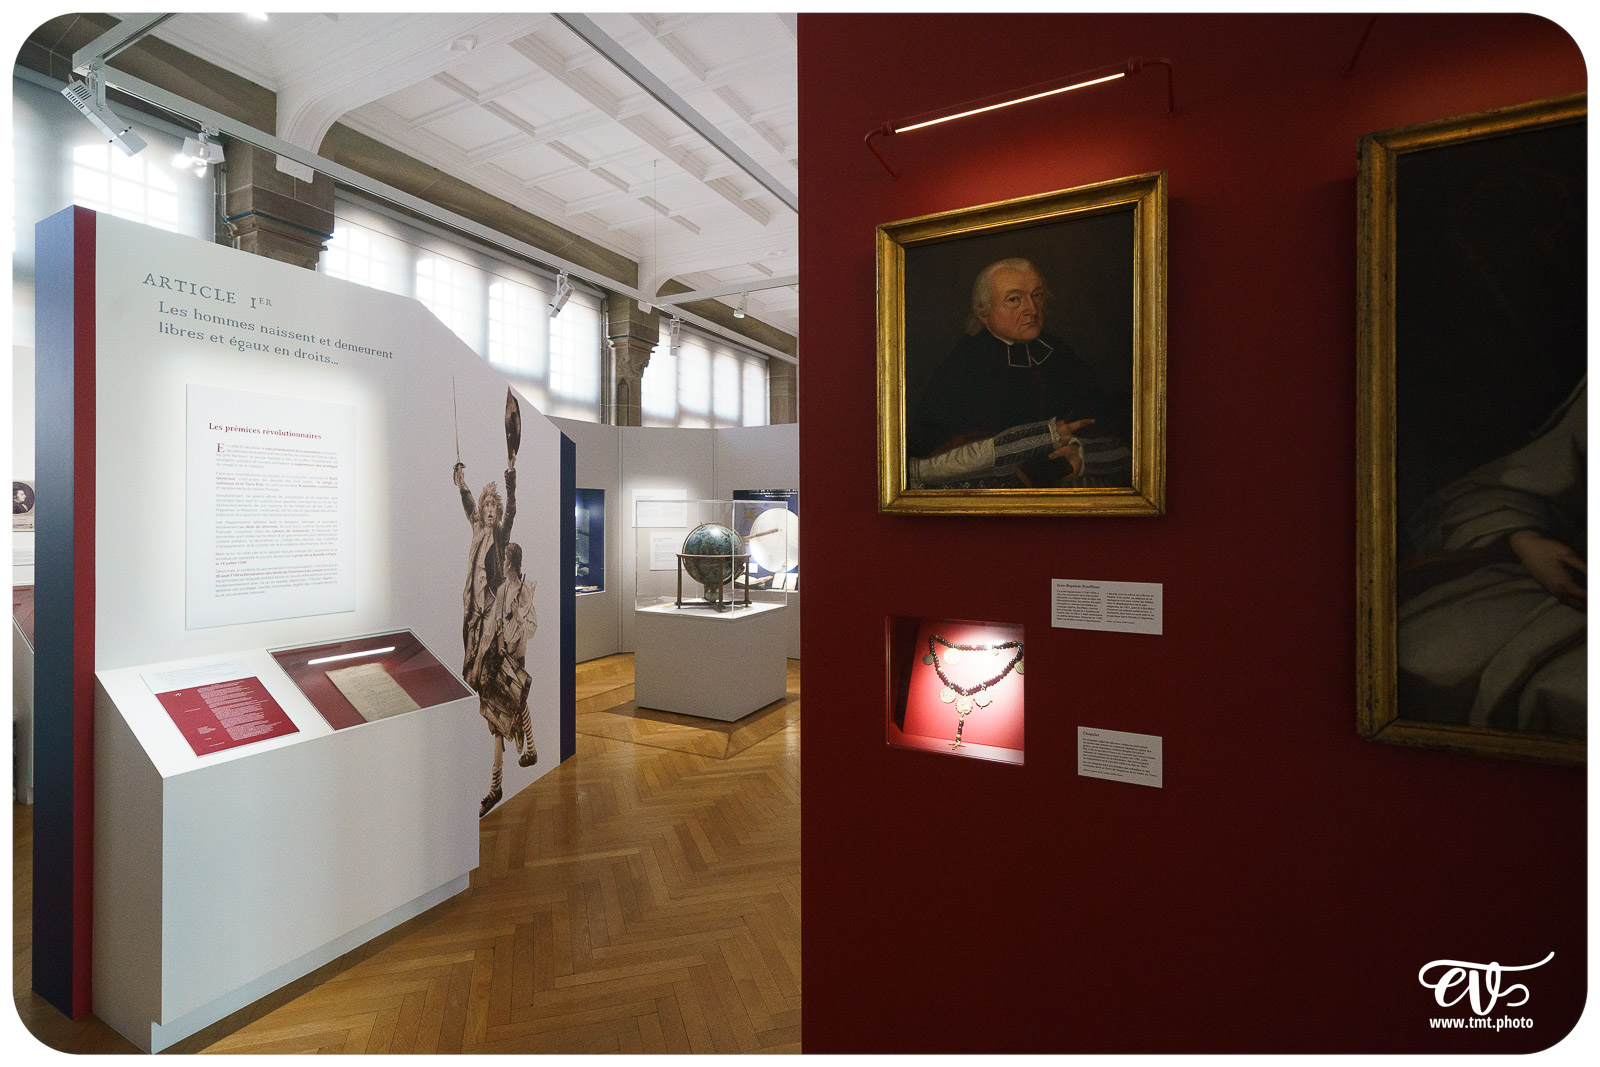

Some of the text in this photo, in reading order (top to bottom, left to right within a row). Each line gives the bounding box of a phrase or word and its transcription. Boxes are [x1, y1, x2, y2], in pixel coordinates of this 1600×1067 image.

[142, 273, 237, 305] ARTICLE
[159, 300, 393, 360] Les hommes naissent et demeurent
[159, 321, 205, 341] libres
[209, 334, 225, 345] et
[229, 336, 270, 353] égaux
[274, 346, 290, 357] en
[208, 422, 322, 440] Les prémices révolutionnaires
